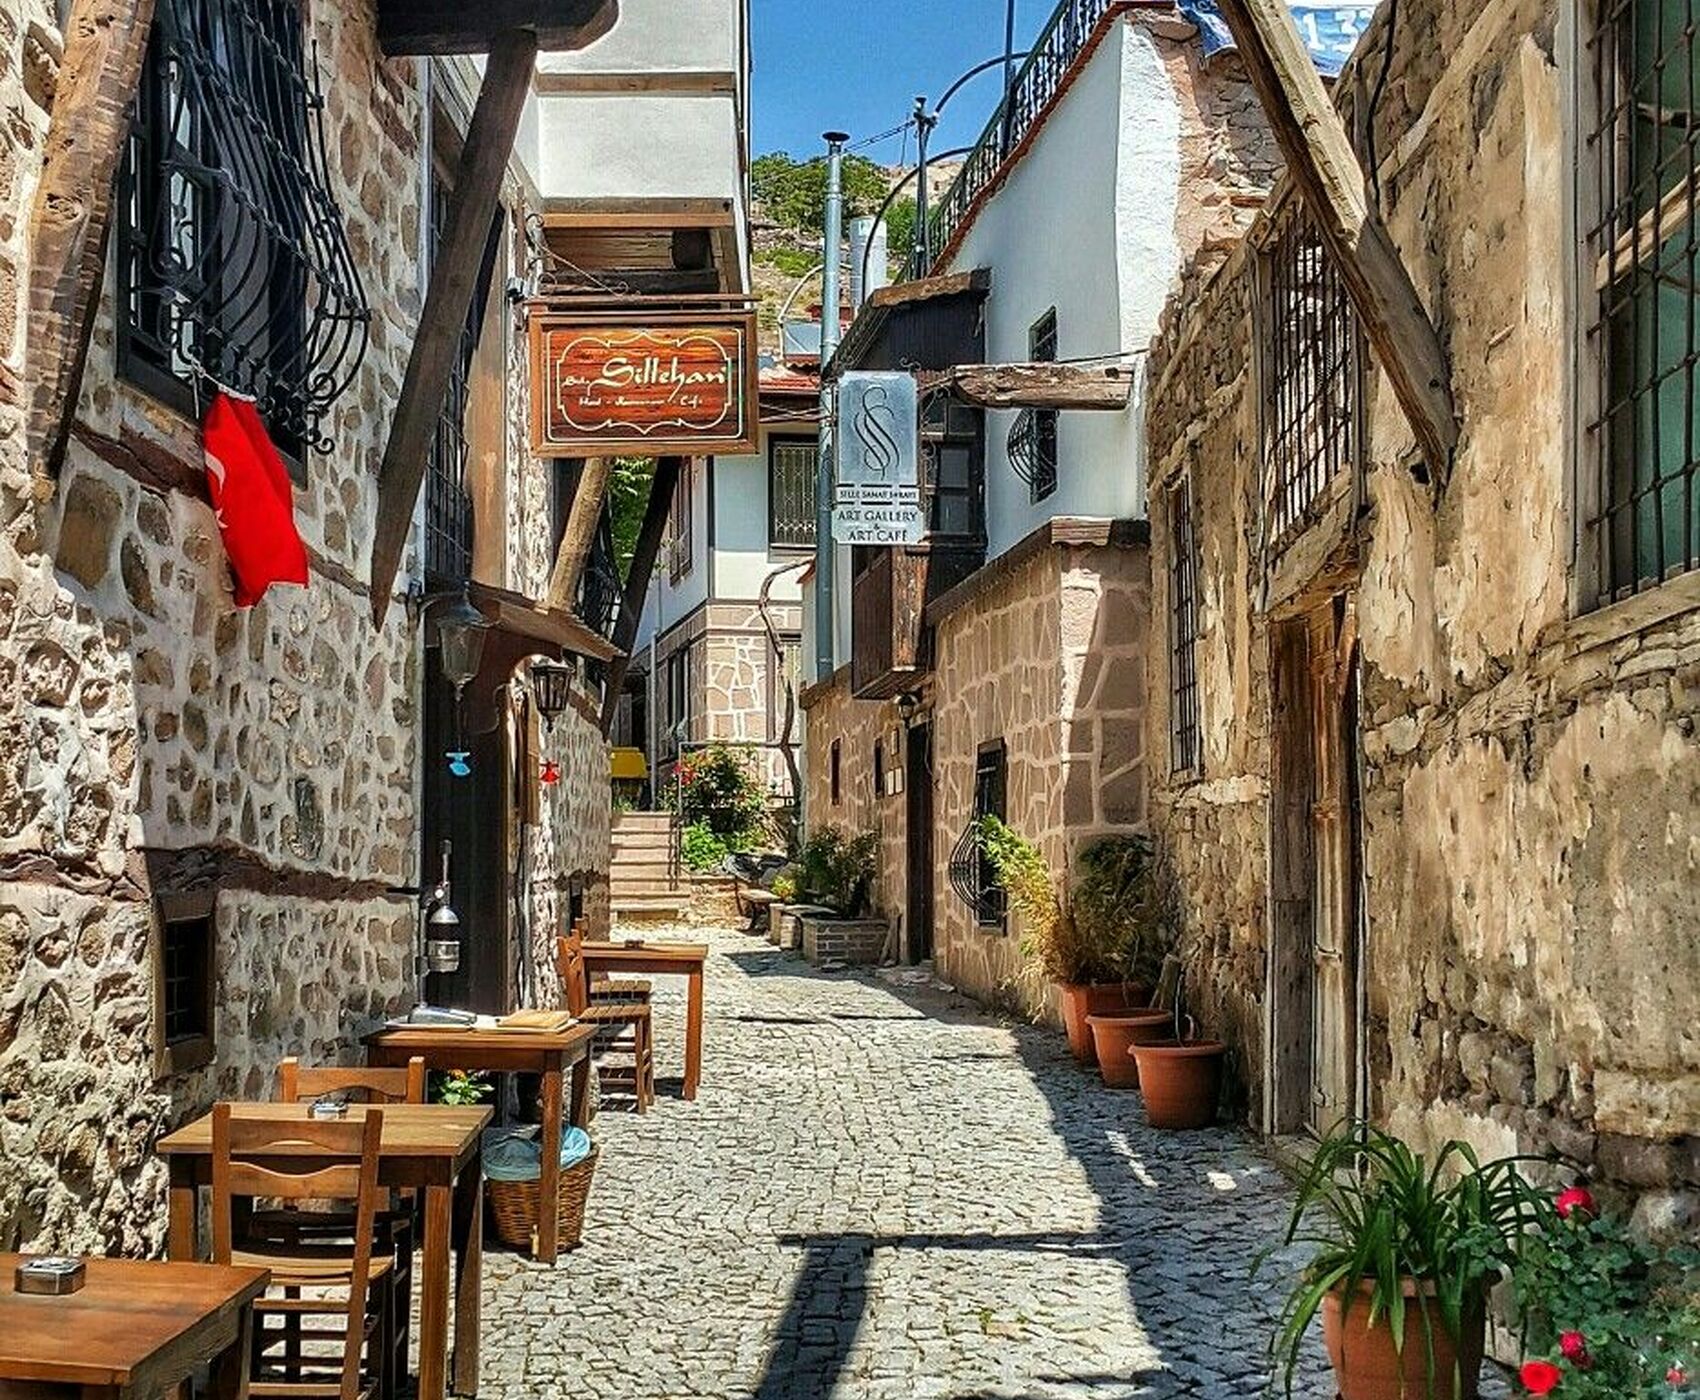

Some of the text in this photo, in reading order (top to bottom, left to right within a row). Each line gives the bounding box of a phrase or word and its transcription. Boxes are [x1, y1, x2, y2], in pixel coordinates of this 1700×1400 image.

[837, 510, 917, 522] ART GALLERY
[848, 531, 873, 541] ART
